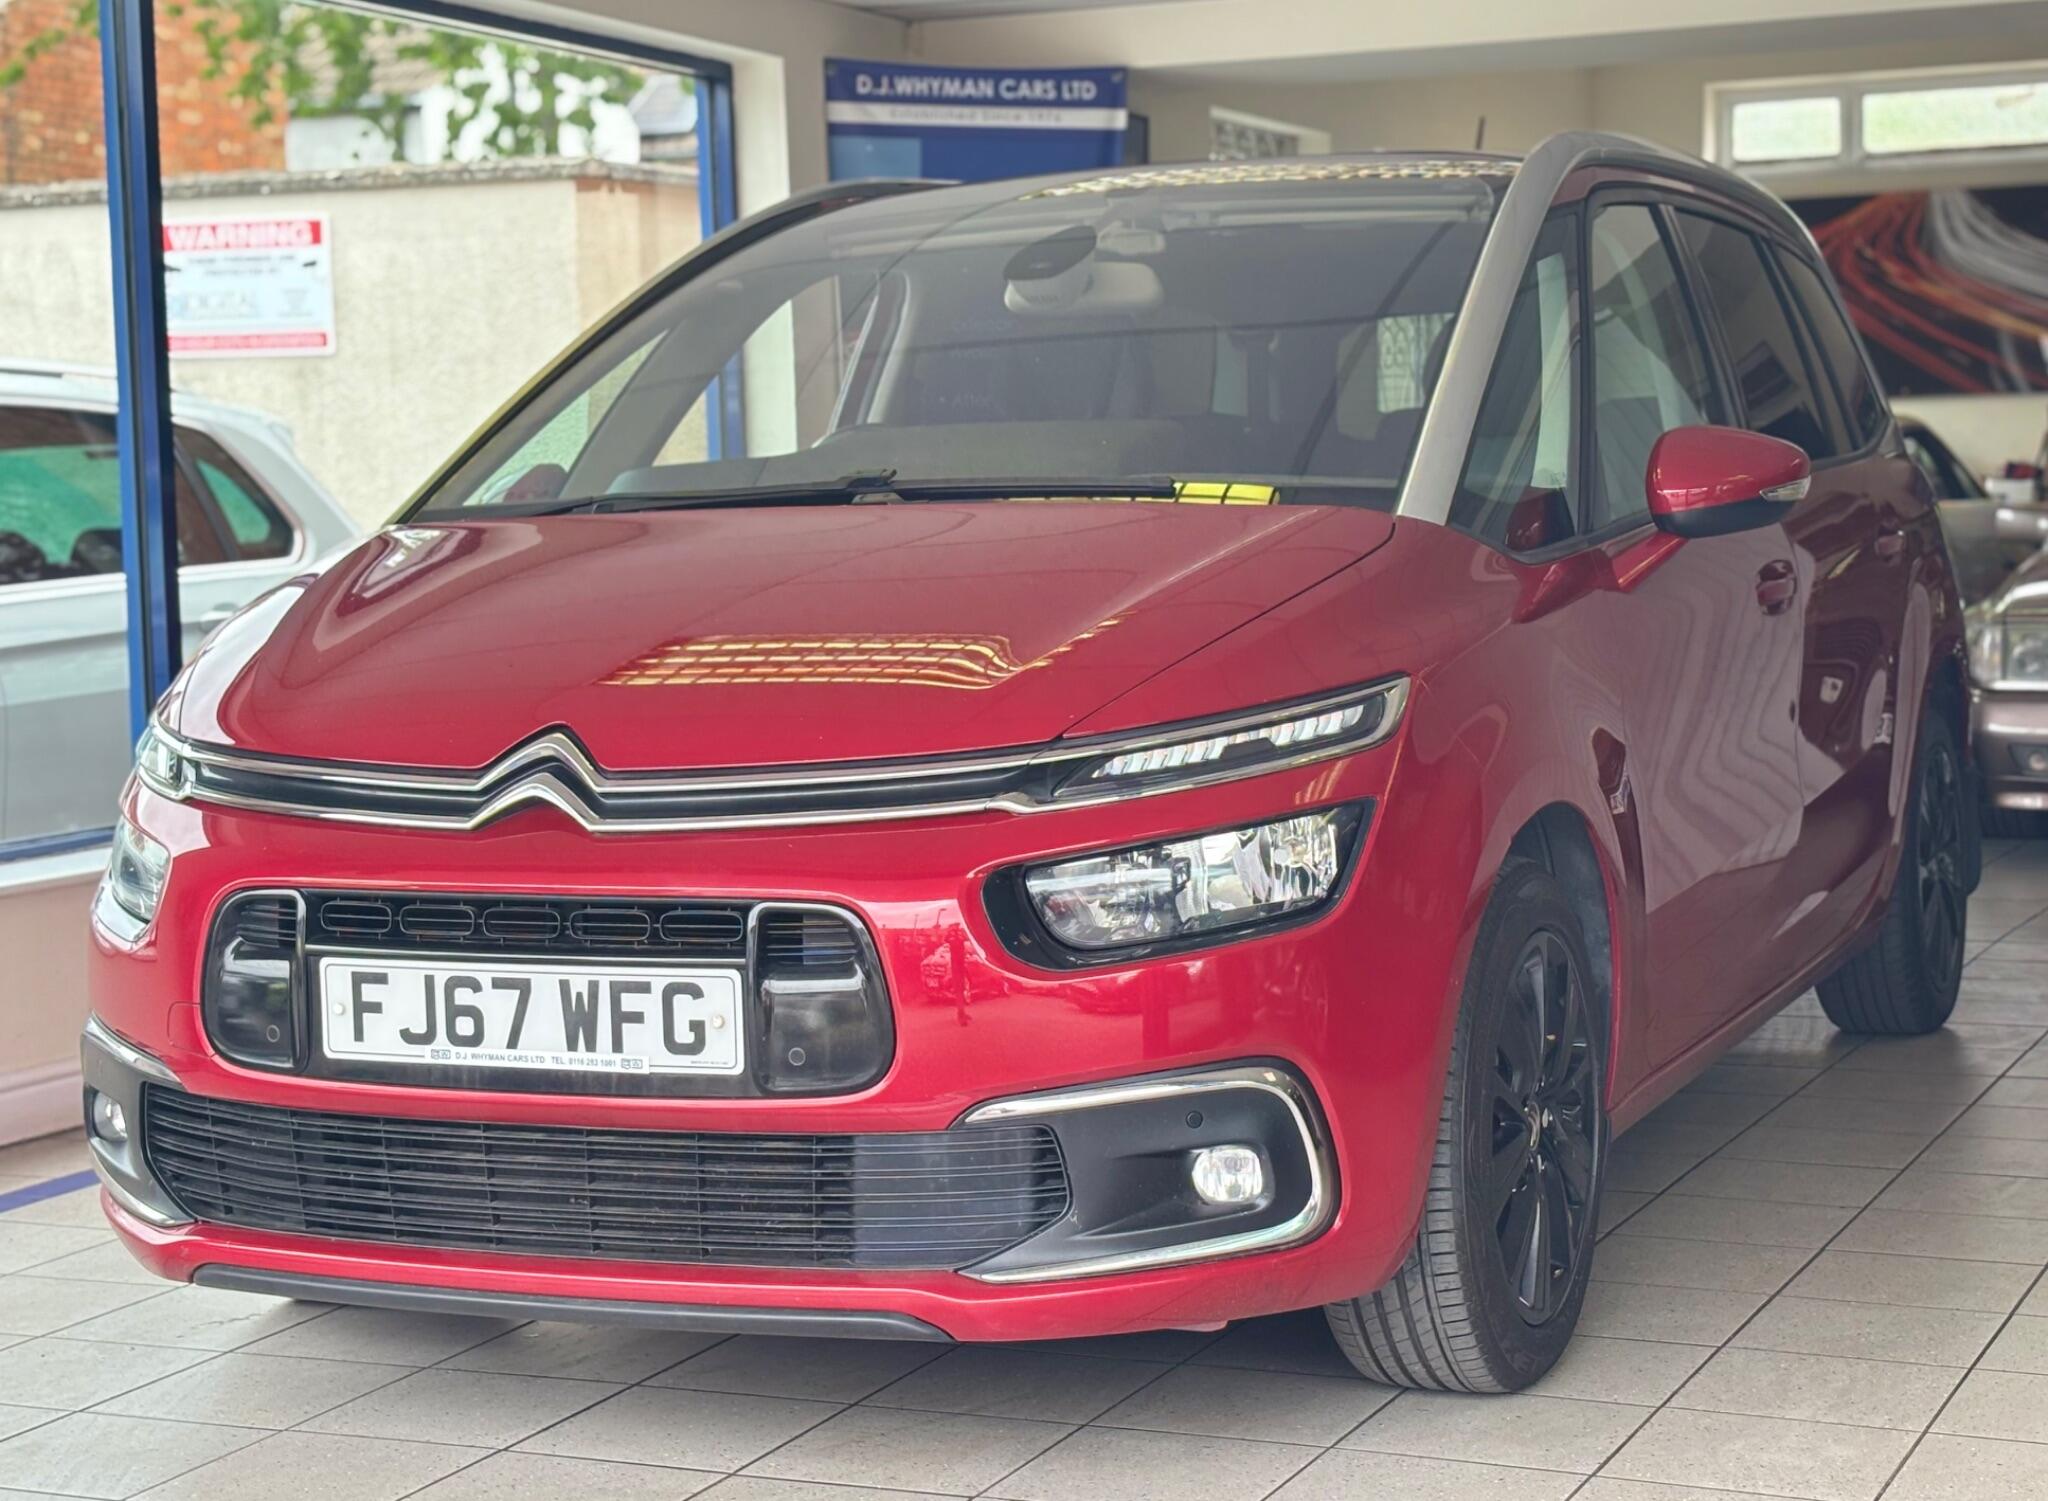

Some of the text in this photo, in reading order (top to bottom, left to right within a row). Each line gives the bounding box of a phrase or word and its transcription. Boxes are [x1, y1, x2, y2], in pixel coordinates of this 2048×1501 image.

[999, 79, 1057, 100] CARS
[1061, 81, 1097, 100] LTD
[168, 222, 312, 251] WARNING
[351, 970, 707, 1057] FJ67 WFG
[470, 1053, 506, 1062] WHYMAN
[507, 1054, 529, 1064] CARS
[530, 1056, 545, 1064] LTD
